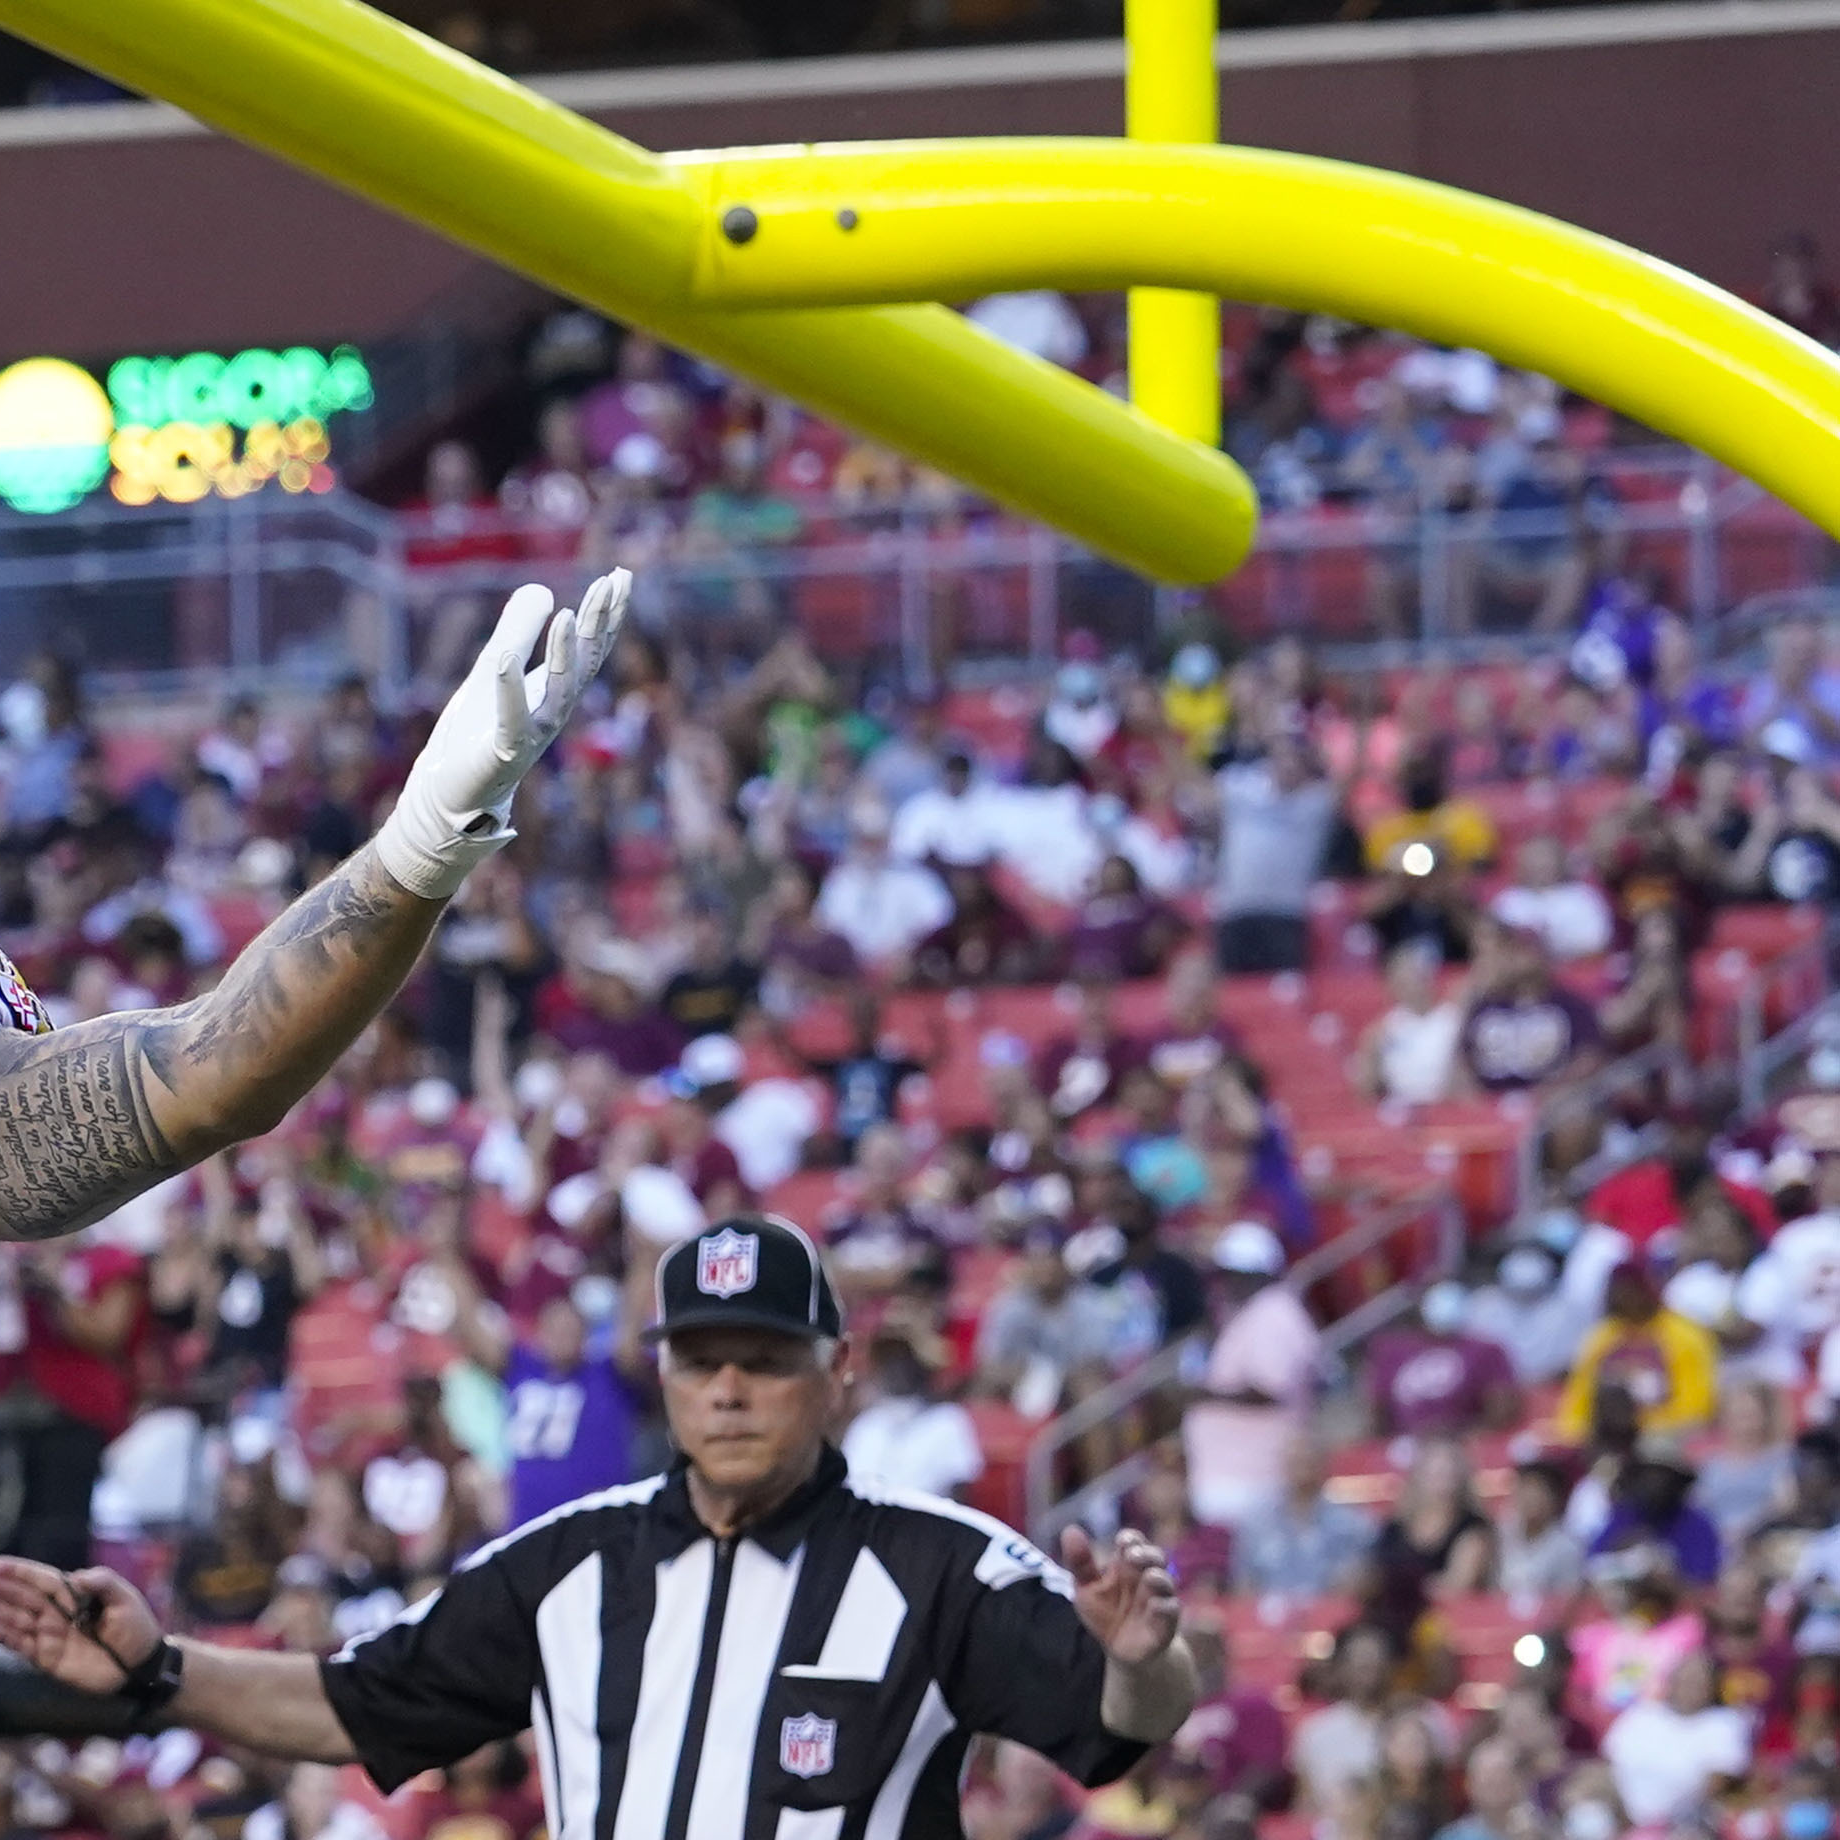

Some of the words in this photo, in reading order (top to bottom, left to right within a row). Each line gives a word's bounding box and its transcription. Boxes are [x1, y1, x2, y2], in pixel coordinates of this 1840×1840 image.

[16, 1081, 47, 1123] from
[71, 1080, 96, 1115] and
[99, 1092, 131, 1125] for
[25, 1128, 42, 1148] us
[704, 1256, 749, 1290] NFL
[786, 1739, 829, 1772] NFL
